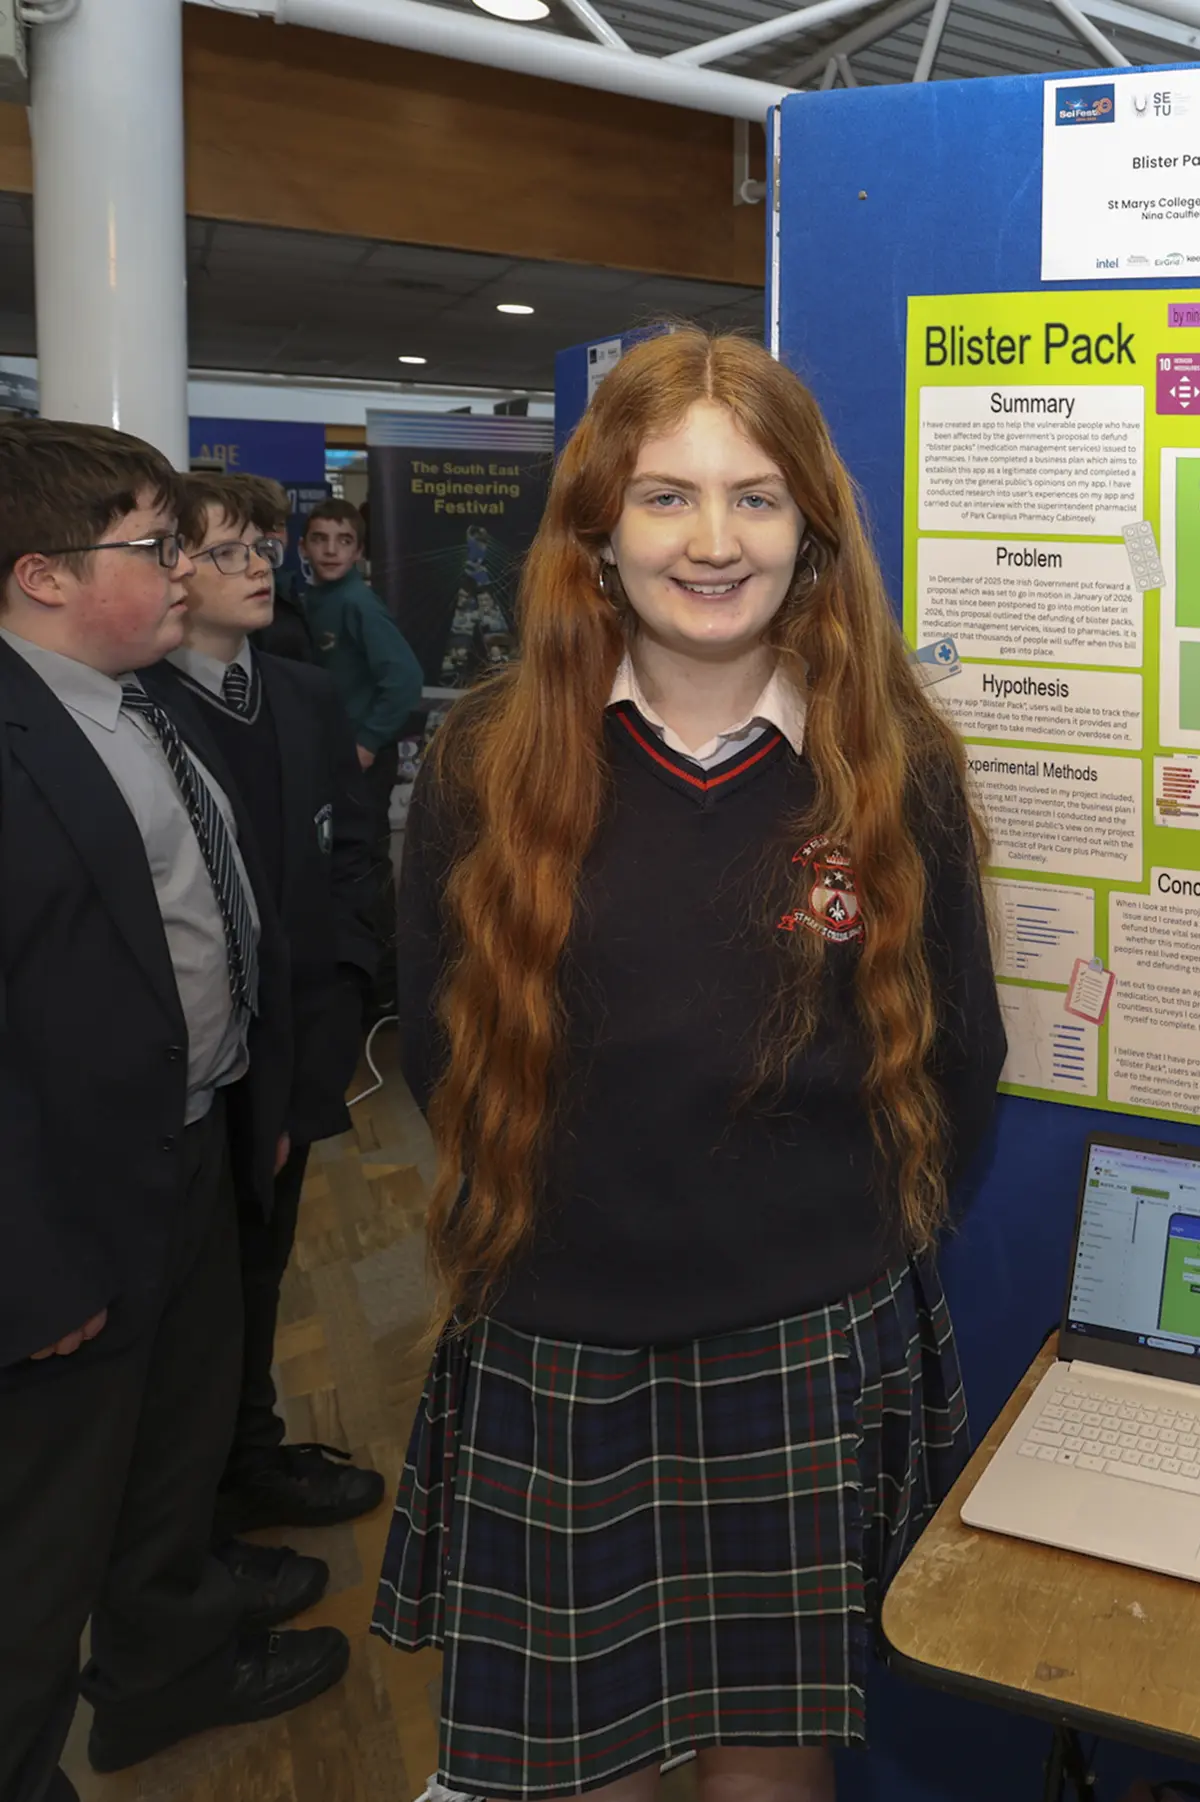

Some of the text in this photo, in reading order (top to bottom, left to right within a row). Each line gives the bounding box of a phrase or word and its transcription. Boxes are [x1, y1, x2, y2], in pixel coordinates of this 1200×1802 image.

[1154, 92, 1171, 104] SE
[1154, 105, 1171, 116] TU
[1133, 156, 1178, 169] Blister
[1108, 200, 1118, 209] St
[1122, 200, 1155, 211] Marys
[1142, 210, 1163, 219] Nina
[1096, 258, 1118, 268] intel
[1174, 308, 1184, 326] by
[926, 322, 1136, 366] Blister Pack
[1160, 358, 1171, 371] 10
[991, 392, 1075, 419] Summary
[926, 420, 943, 428] have
[944, 420, 970, 428] created
[1005, 421, 1021, 430] help
[1077, 421, 1102, 430] people
[1056, 432, 1089, 441] proposal
[1100, 432, 1127, 440] defund
[411, 461, 519, 476] The South East
[411, 479, 520, 498] Engineering
[434, 499, 504, 514] Festival
[997, 547, 1062, 568] Problem
[937, 575, 973, 583] December
[1002, 577, 1014, 585] the
[1016, 578, 1031, 586] Irish
[1033, 579, 1078, 588] Government
[1080, 581, 1093, 590] put
[1094, 581, 1124, 590] forward
[1017, 646, 1031, 654] into
[983, 674, 1069, 698] Hypothesis
[977, 722, 998, 732] forget
[1009, 724, 1023, 732] take
[1025, 726, 1065, 735] medication
[1077, 730, 1110, 738] overdose
[968, 757, 1097, 781] xperimental Methods
[1038, 842, 1127, 860] Park Care plus Pharmacy
[1137, 960, 1150, 968] and
[1152, 961, 1190, 974] defunding
[1130, 1097, 1170, 1107] conclusion
[1171, 1101, 1200, 1113] through
